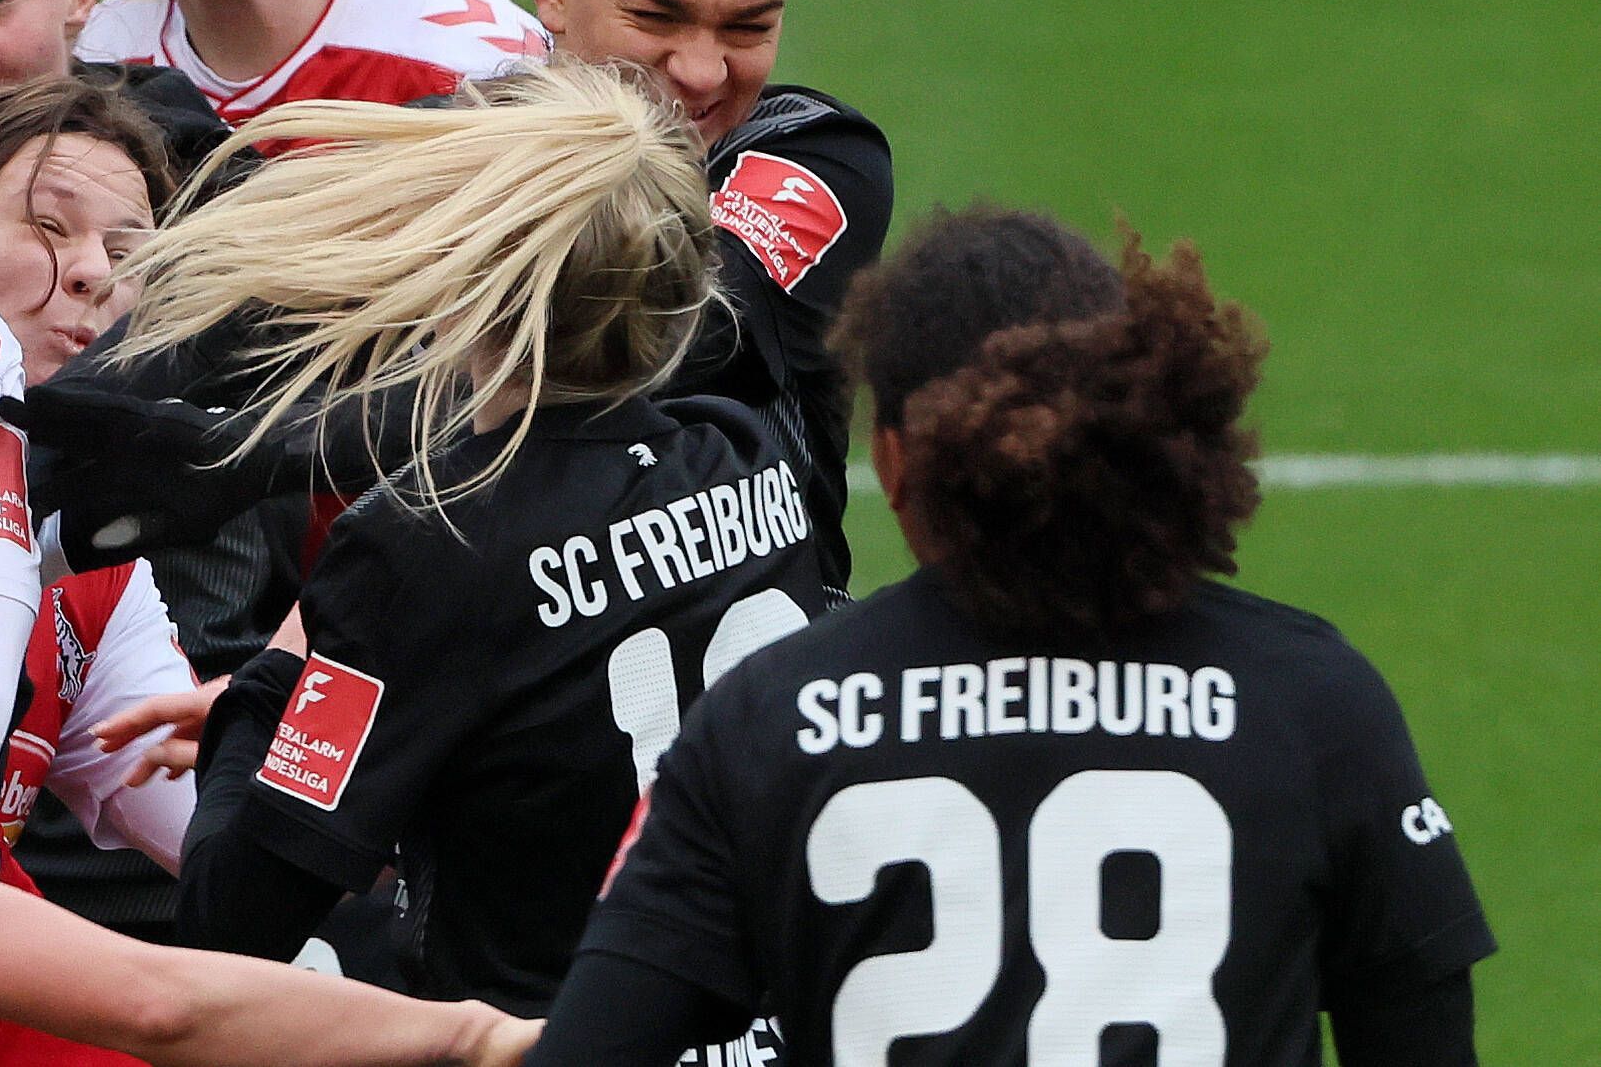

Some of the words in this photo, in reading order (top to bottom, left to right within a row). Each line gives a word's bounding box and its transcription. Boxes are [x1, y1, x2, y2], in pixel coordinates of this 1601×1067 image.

[711, 206, 788, 281] BUNDESLIGA
[528, 535, 608, 628] SC
[609, 459, 808, 601] FREIBURG
[607, 587, 811, 799] 1
[797, 672, 885, 755] SC
[900, 656, 1237, 742] FREIBURG
[264, 753, 330, 793] NDESLIGA
[269, 737, 309, 764] AUEN-
[278, 721, 345, 762] ERALARM
[1401, 797, 1454, 845] CA
[807, 769, 1235, 1067] 28
